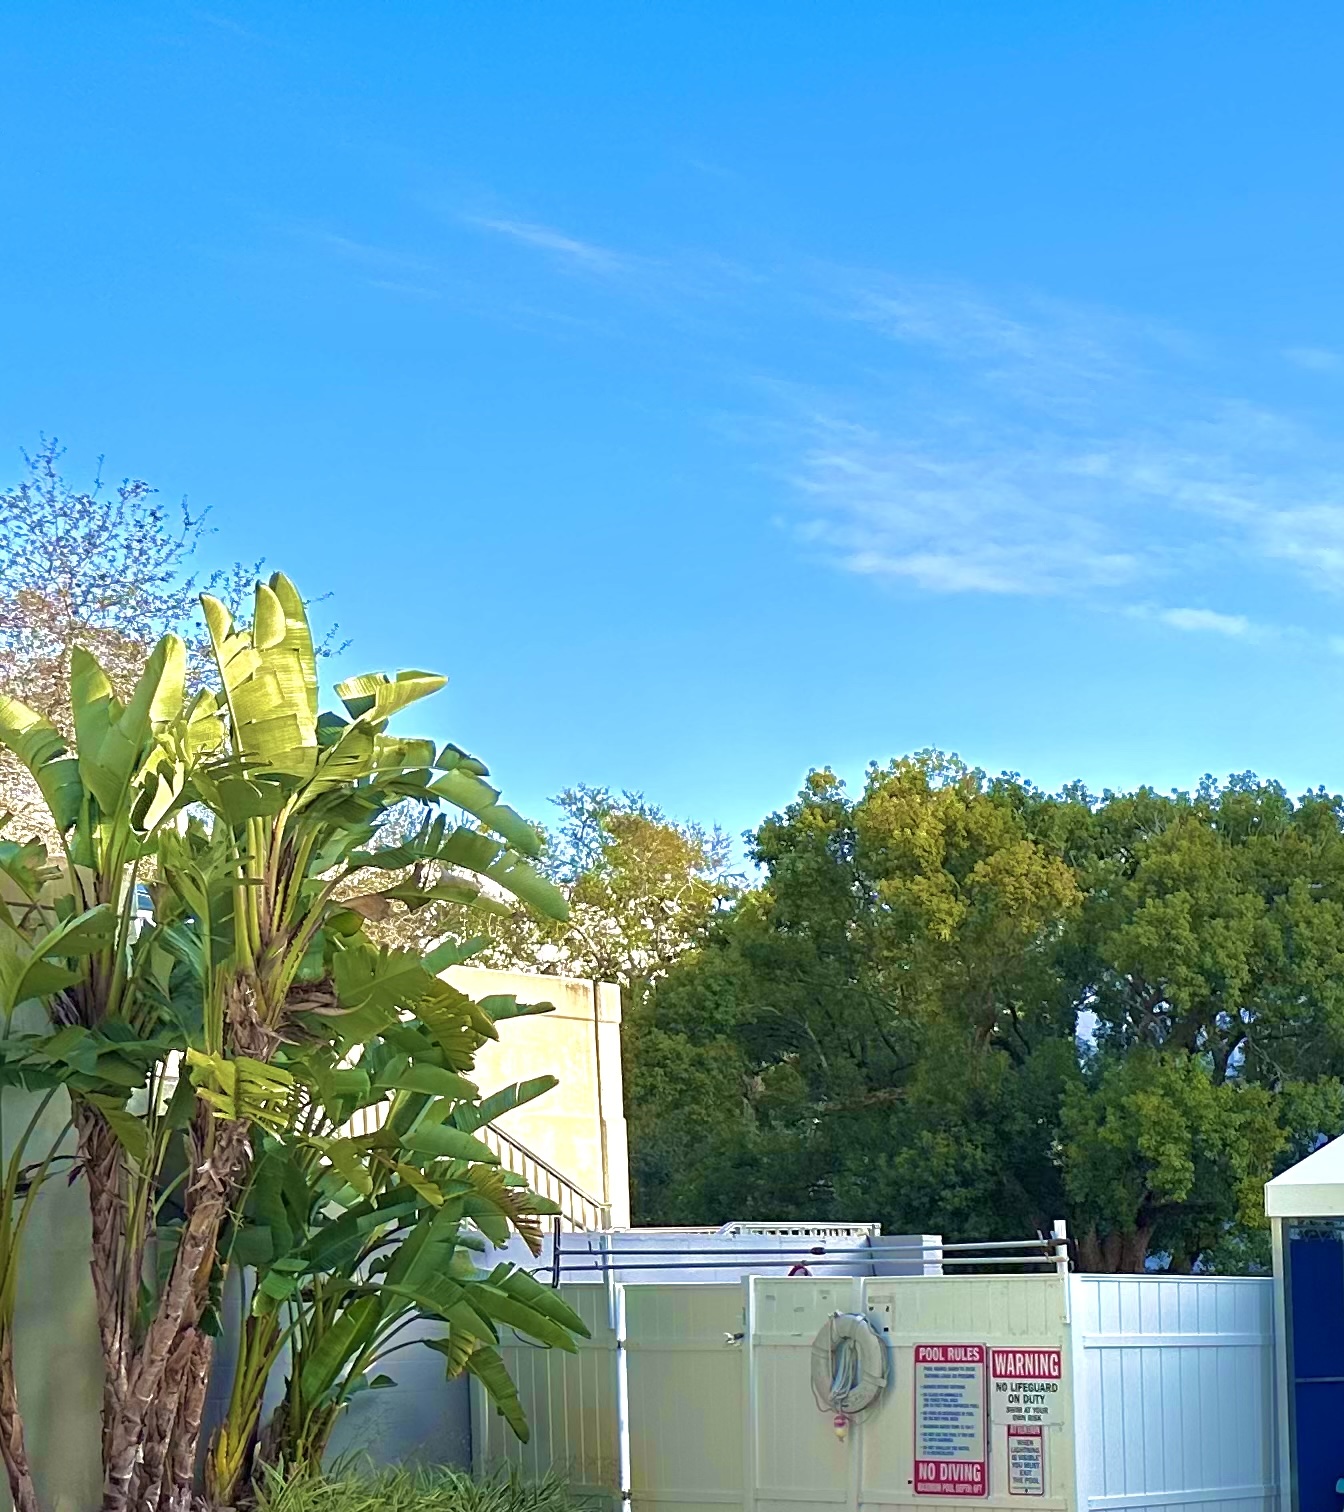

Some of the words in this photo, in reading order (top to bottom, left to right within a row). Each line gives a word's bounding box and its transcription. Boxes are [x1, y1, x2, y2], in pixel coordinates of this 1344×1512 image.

[919, 1347, 945, 1361] POOL
[947, 1347, 980, 1361] RULES
[994, 1353, 1059, 1376] WARNING
[995, 1382, 1008, 1392] NO
[1010, 1382, 1058, 1393] LIFEGUARD
[1008, 1394, 1020, 1404] ON
[1023, 1394, 1045, 1404] DUTY
[919, 1462, 936, 1480] NO
[940, 1463, 981, 1482] DIVING
